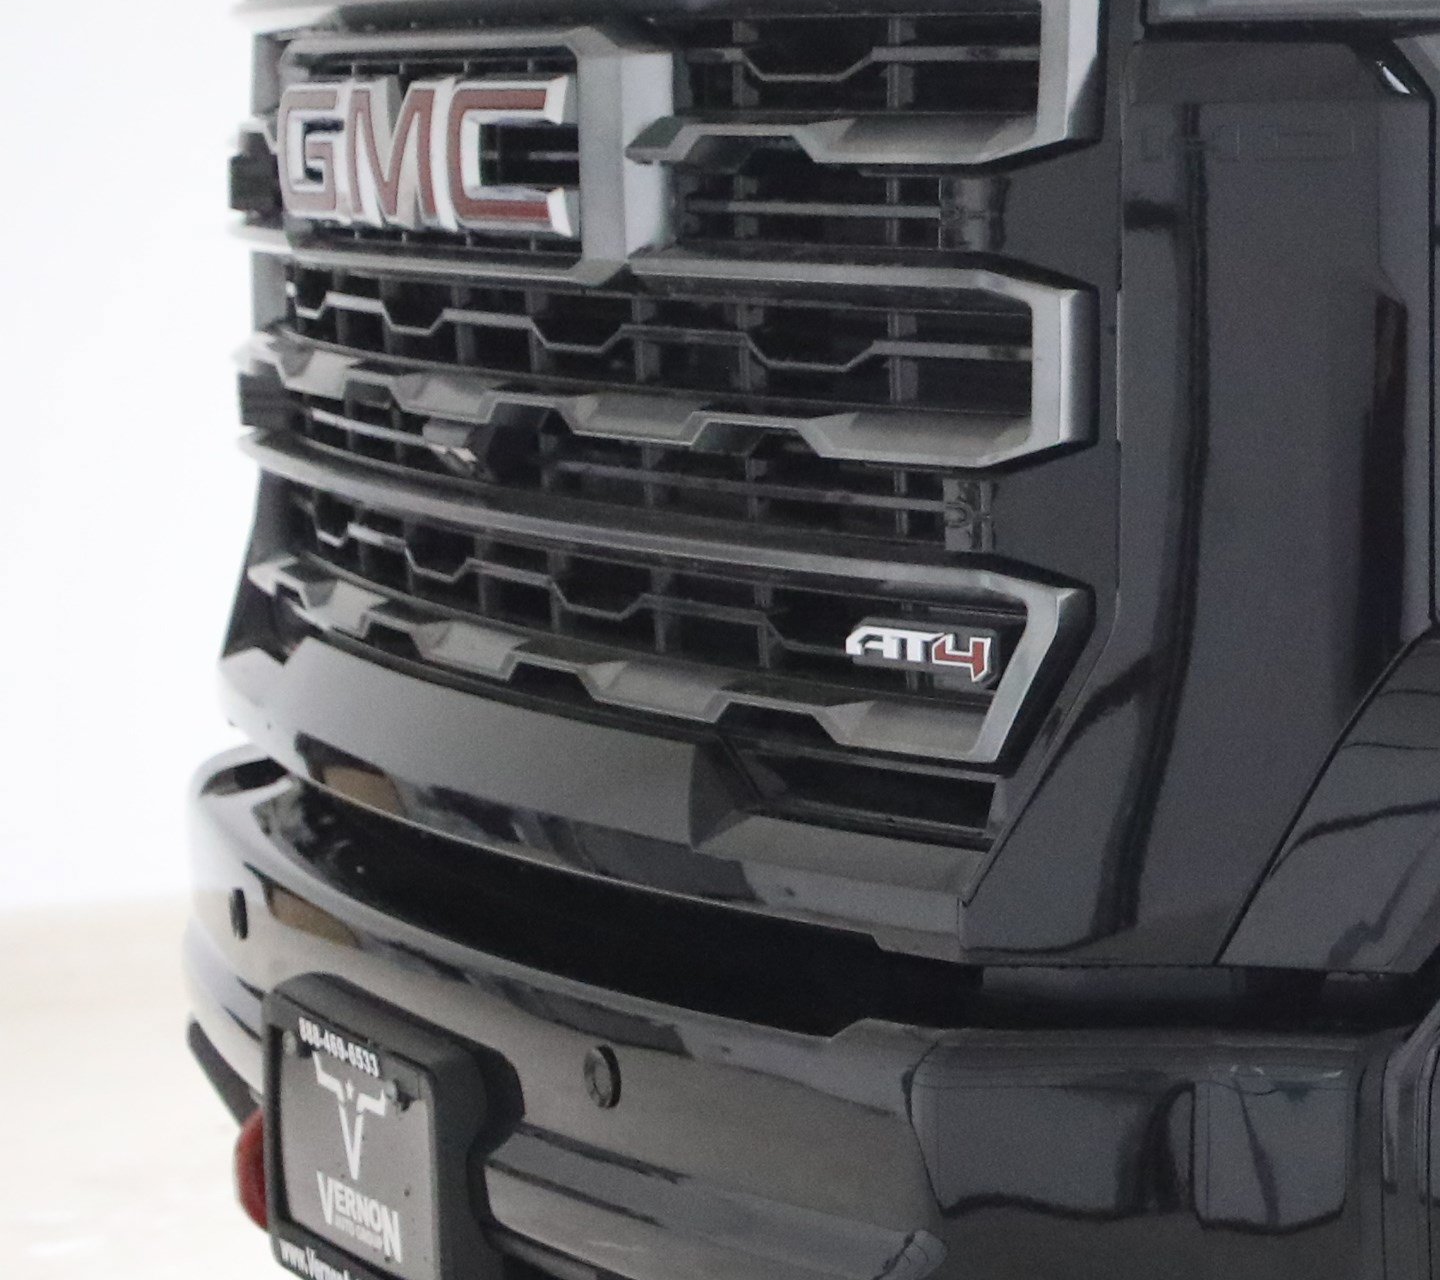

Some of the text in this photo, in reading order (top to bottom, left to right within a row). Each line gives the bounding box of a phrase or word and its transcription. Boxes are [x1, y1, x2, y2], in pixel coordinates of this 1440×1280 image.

[277, 75, 576, 240] GMC
[845, 626, 992, 683] AT4
[316, 1170, 403, 1264] VERNON
